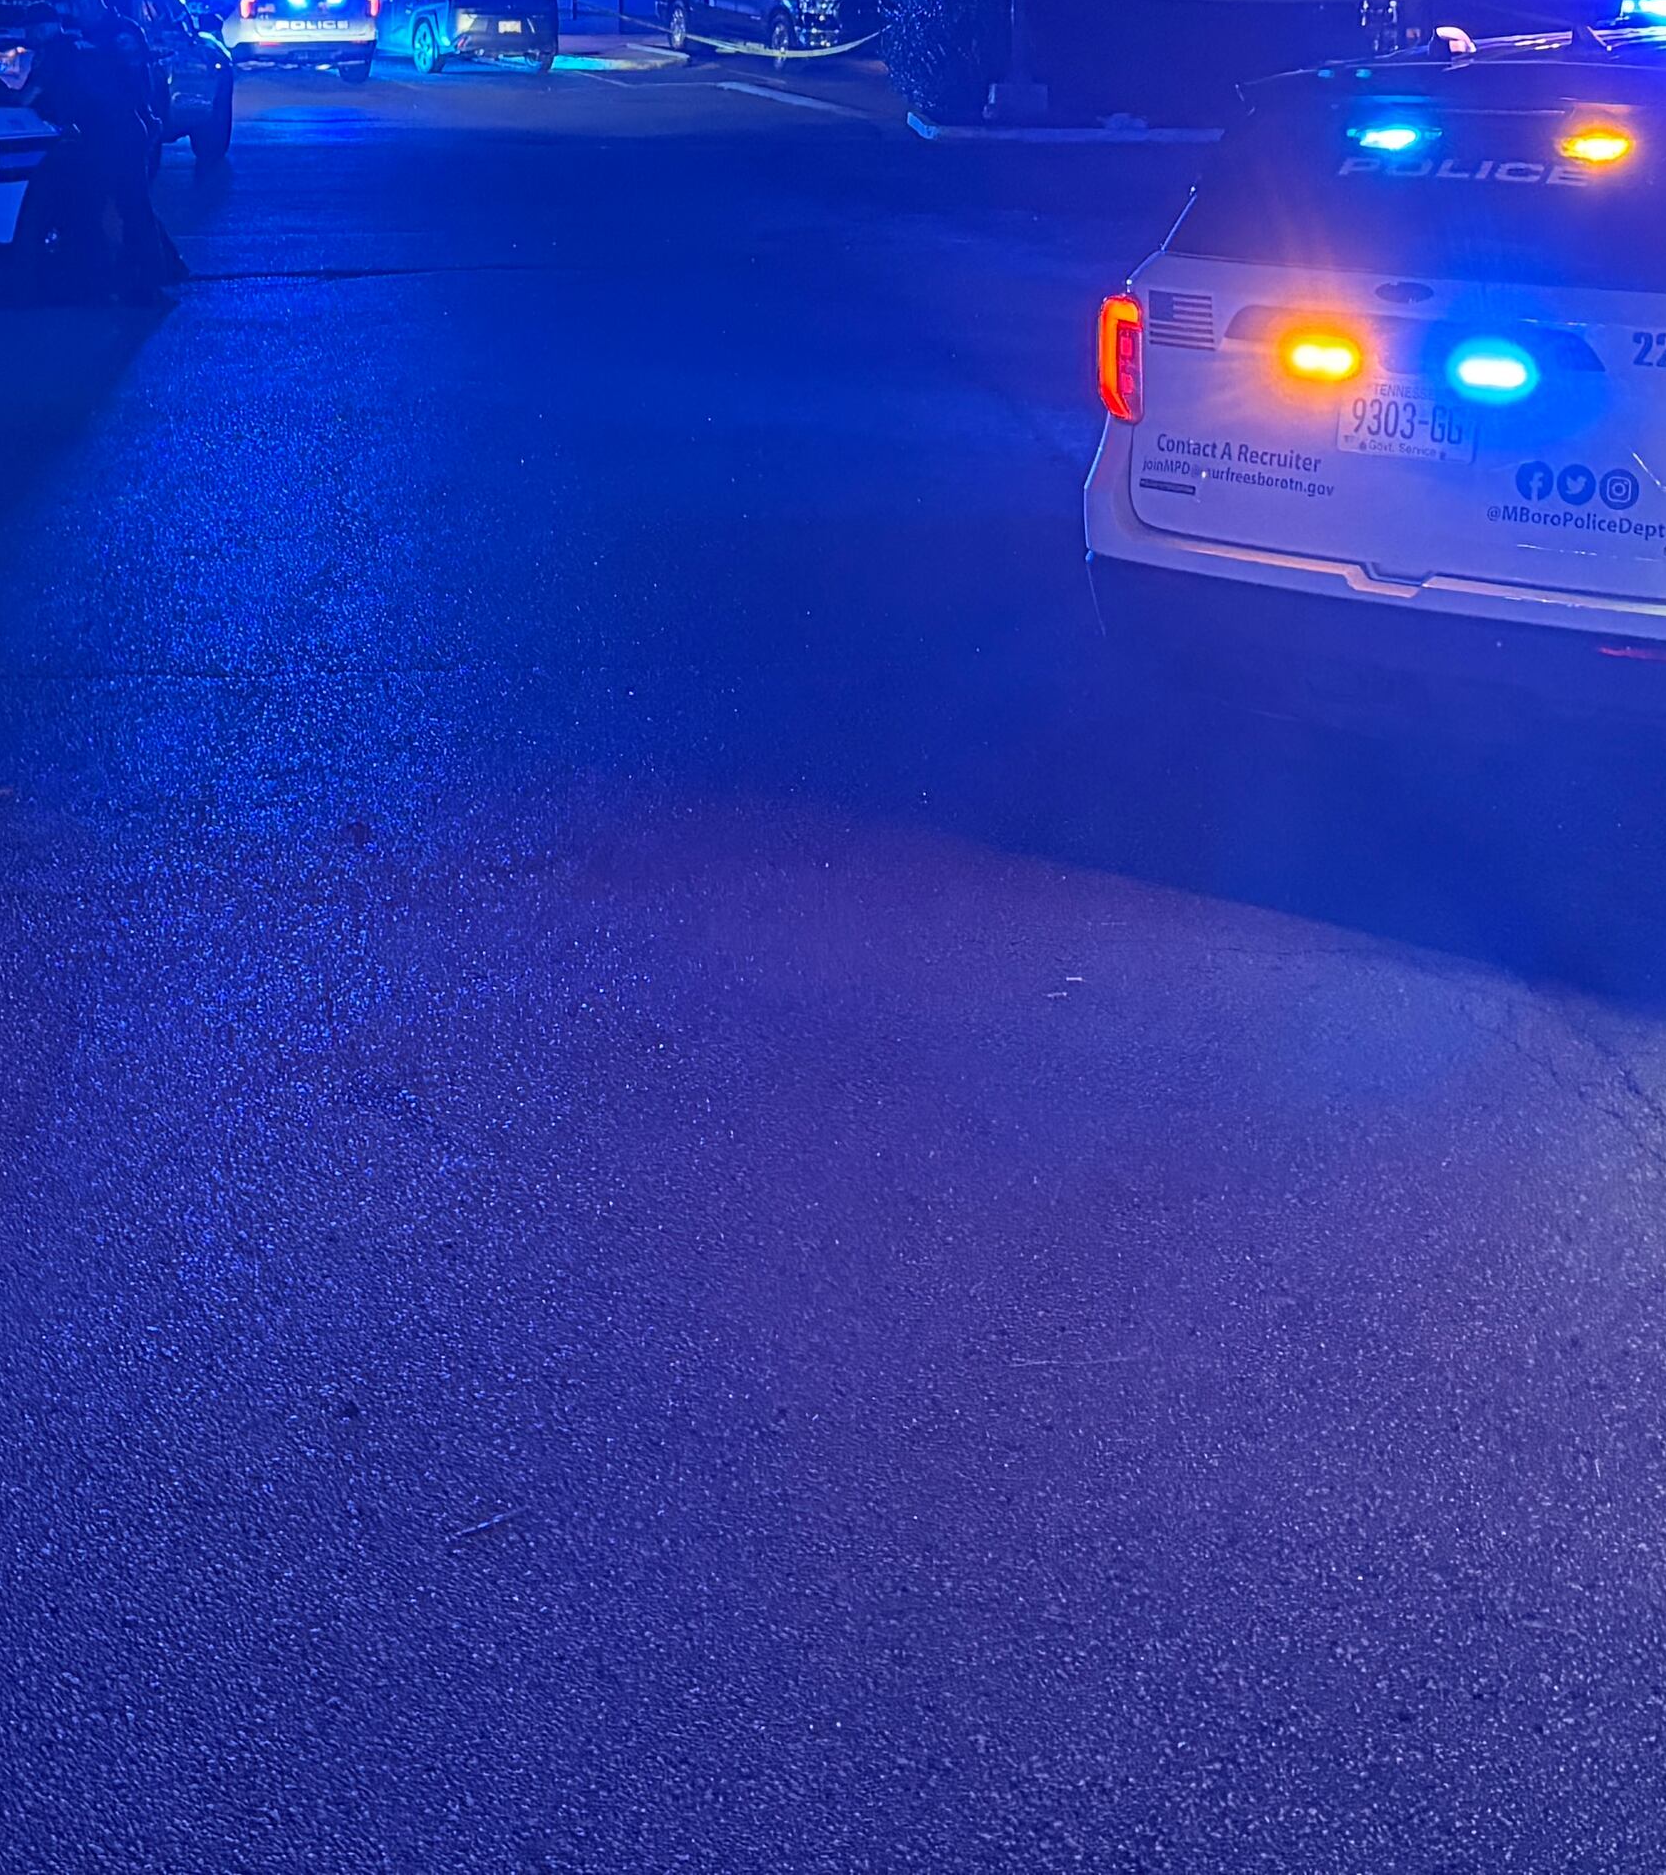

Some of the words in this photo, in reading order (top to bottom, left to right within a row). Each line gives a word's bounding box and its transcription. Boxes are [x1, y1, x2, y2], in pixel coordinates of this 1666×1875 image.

[274, 20, 349, 30] POLICE
[1338, 156, 1595, 187] POLICE
[1373, 383, 1439, 403] TENNESSE
[1157, 433, 1218, 458] Contact
[1220, 442, 1233, 461] A
[1237, 444, 1322, 473] Recruiter
[1368, 439, 1395, 453] Govt.
[1399, 442, 1437, 457] Service
[1486, 504, 1666, 541] @MBoroPoliceDept
